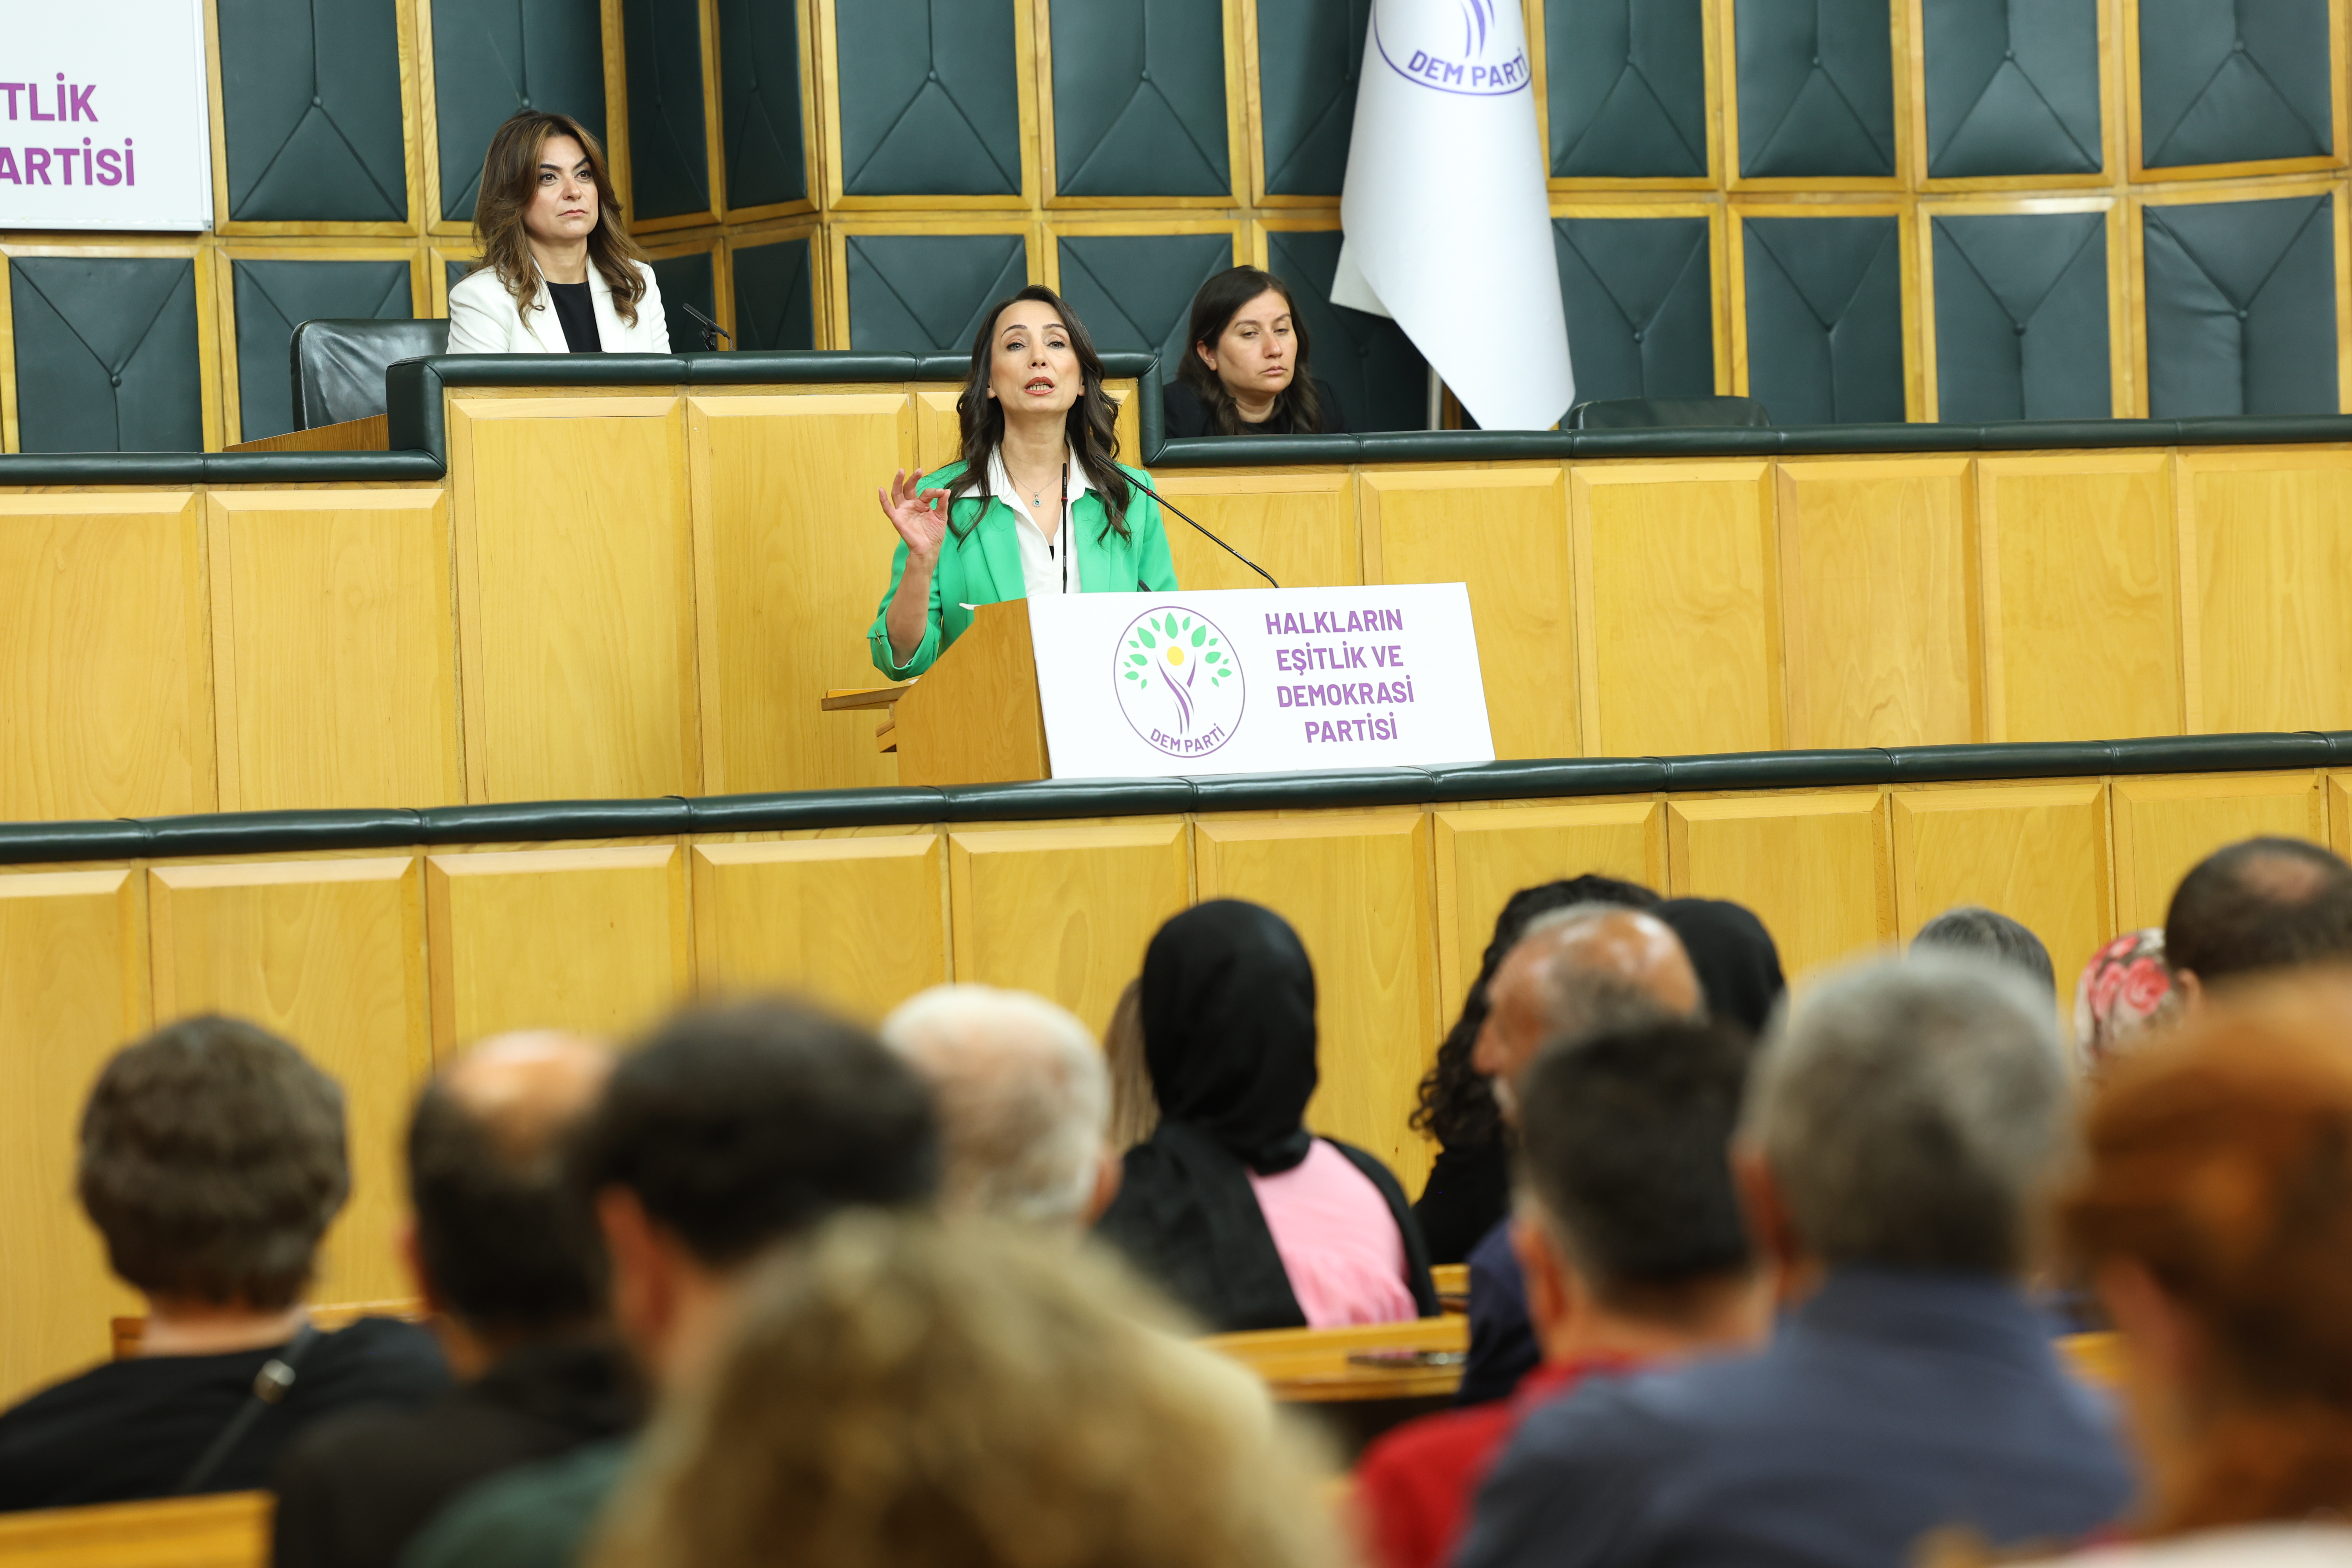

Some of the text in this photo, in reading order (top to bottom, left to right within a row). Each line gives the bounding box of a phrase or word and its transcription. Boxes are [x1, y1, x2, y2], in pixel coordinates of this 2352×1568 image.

[1408, 47, 1528, 87] DEM PARTİ
[0, 72, 98, 122] TLİK
[0, 137, 134, 186] ARTİSİ
[1265, 609, 1403, 634] HALKLARIN
[1276, 641, 1404, 675] EŞİTLİK VE
[1277, 674, 1414, 707] DEMOKRASİ
[1150, 723, 1225, 752] DEM PARTİ
[1305, 711, 1397, 743] PARTİSİ
